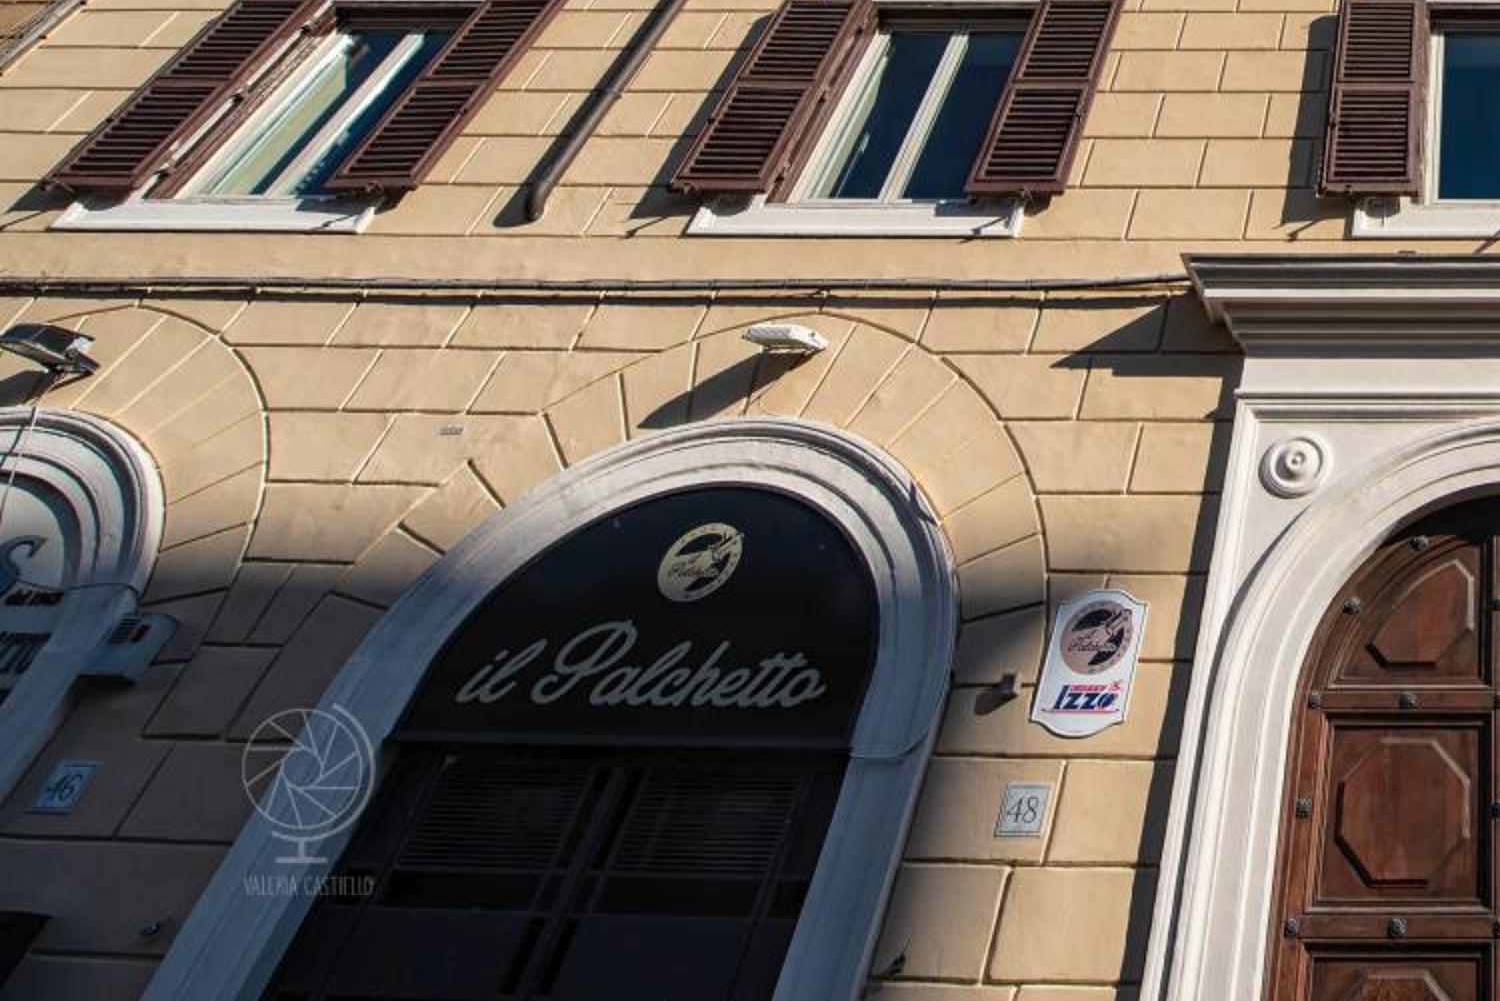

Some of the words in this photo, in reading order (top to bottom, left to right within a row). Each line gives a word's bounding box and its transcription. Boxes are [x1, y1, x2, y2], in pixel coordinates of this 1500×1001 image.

[455, 638, 548, 703] il
[530, 619, 827, 707] Palchetto
[1007, 796, 1040, 824] 48
